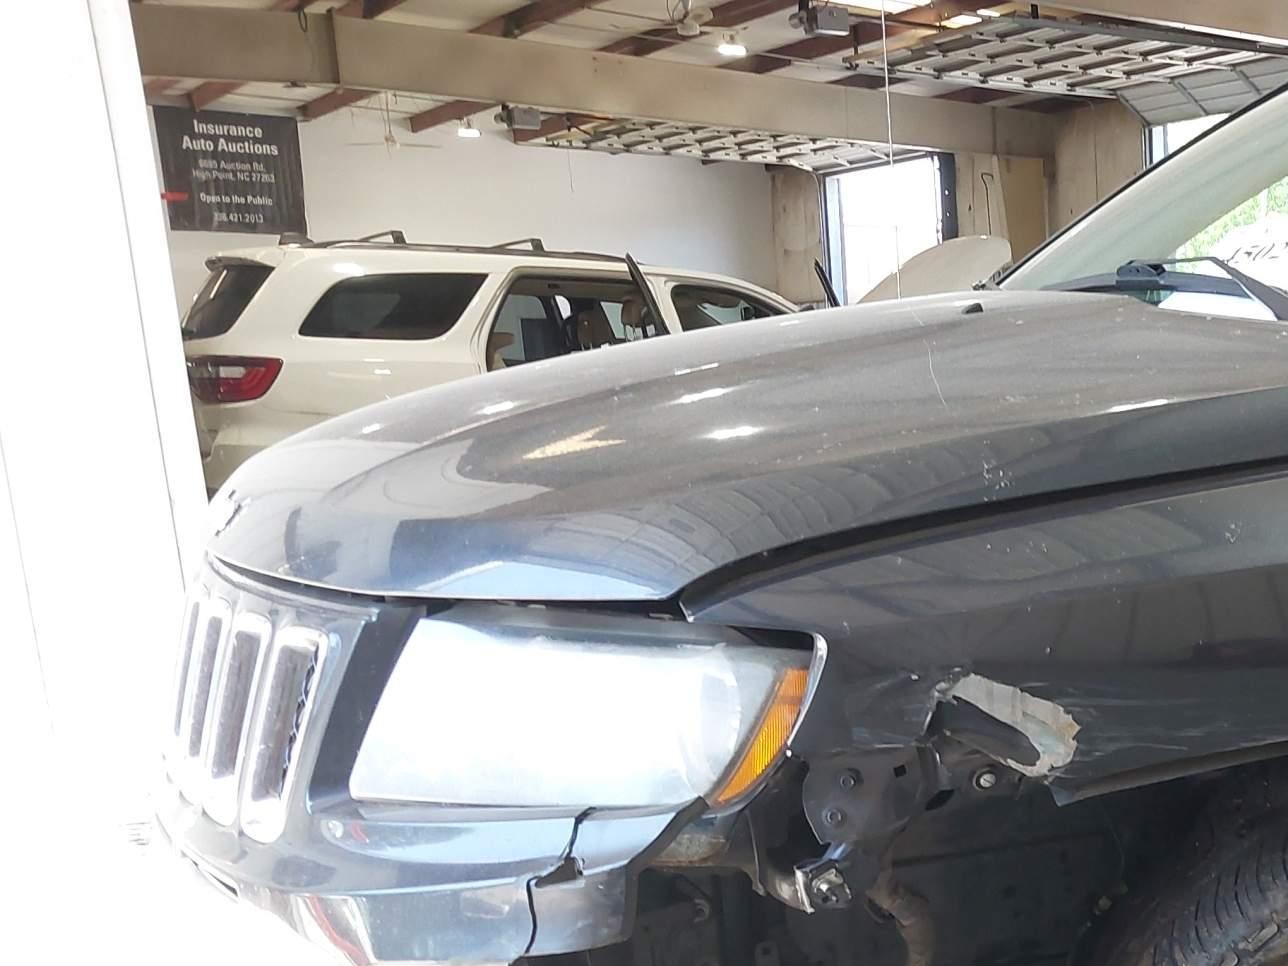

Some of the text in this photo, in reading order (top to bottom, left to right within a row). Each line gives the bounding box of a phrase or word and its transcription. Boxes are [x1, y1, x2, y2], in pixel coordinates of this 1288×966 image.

[193, 119, 263, 138] Insurance
[182, 135, 279, 156] Auto Auctions
[220, 160, 251, 172] Auction
[237, 171, 250, 182] NC
[200, 191, 273, 206] Open to the Public
